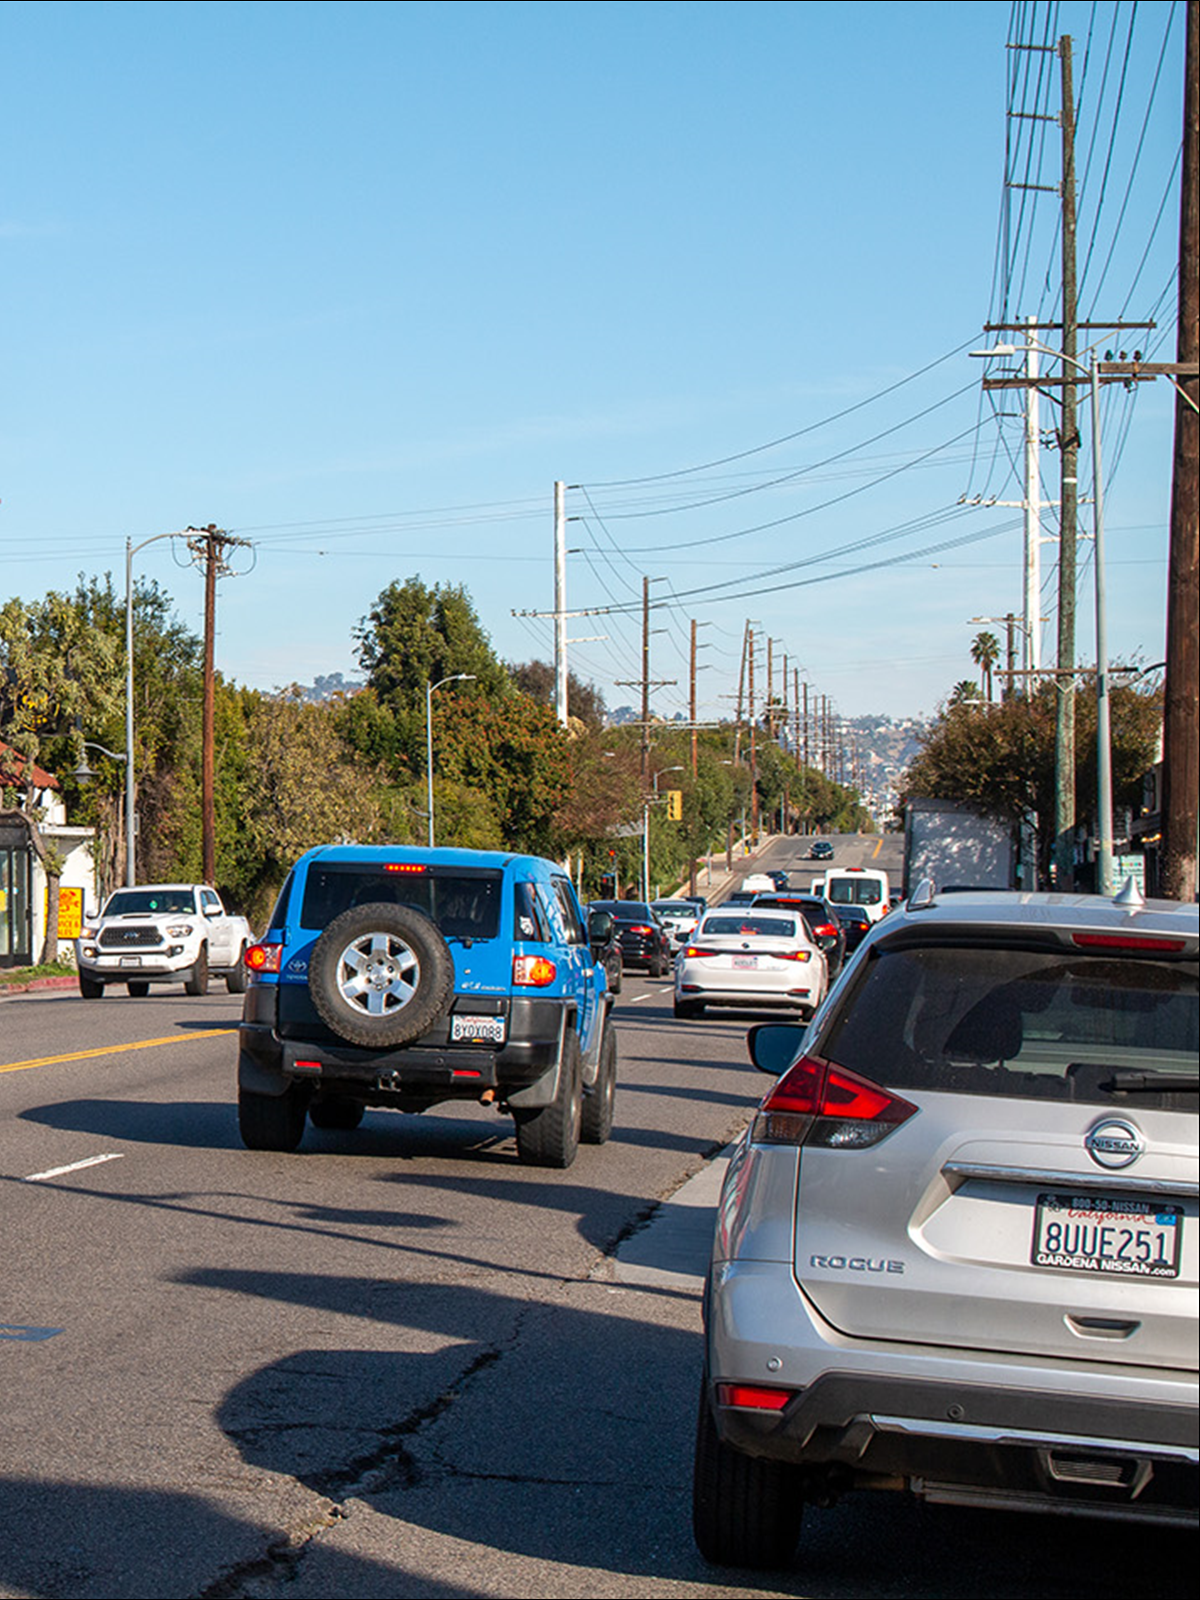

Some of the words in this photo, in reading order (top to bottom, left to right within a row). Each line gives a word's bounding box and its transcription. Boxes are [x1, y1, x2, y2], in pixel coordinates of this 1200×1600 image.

[1091, 1139, 1140, 1152] NISSAN
[1046, 1222, 1169, 1265] 8UUE251
[810, 1255, 906, 1275] ROGUE
[1036, 1253, 1099, 1270] GARDENA
